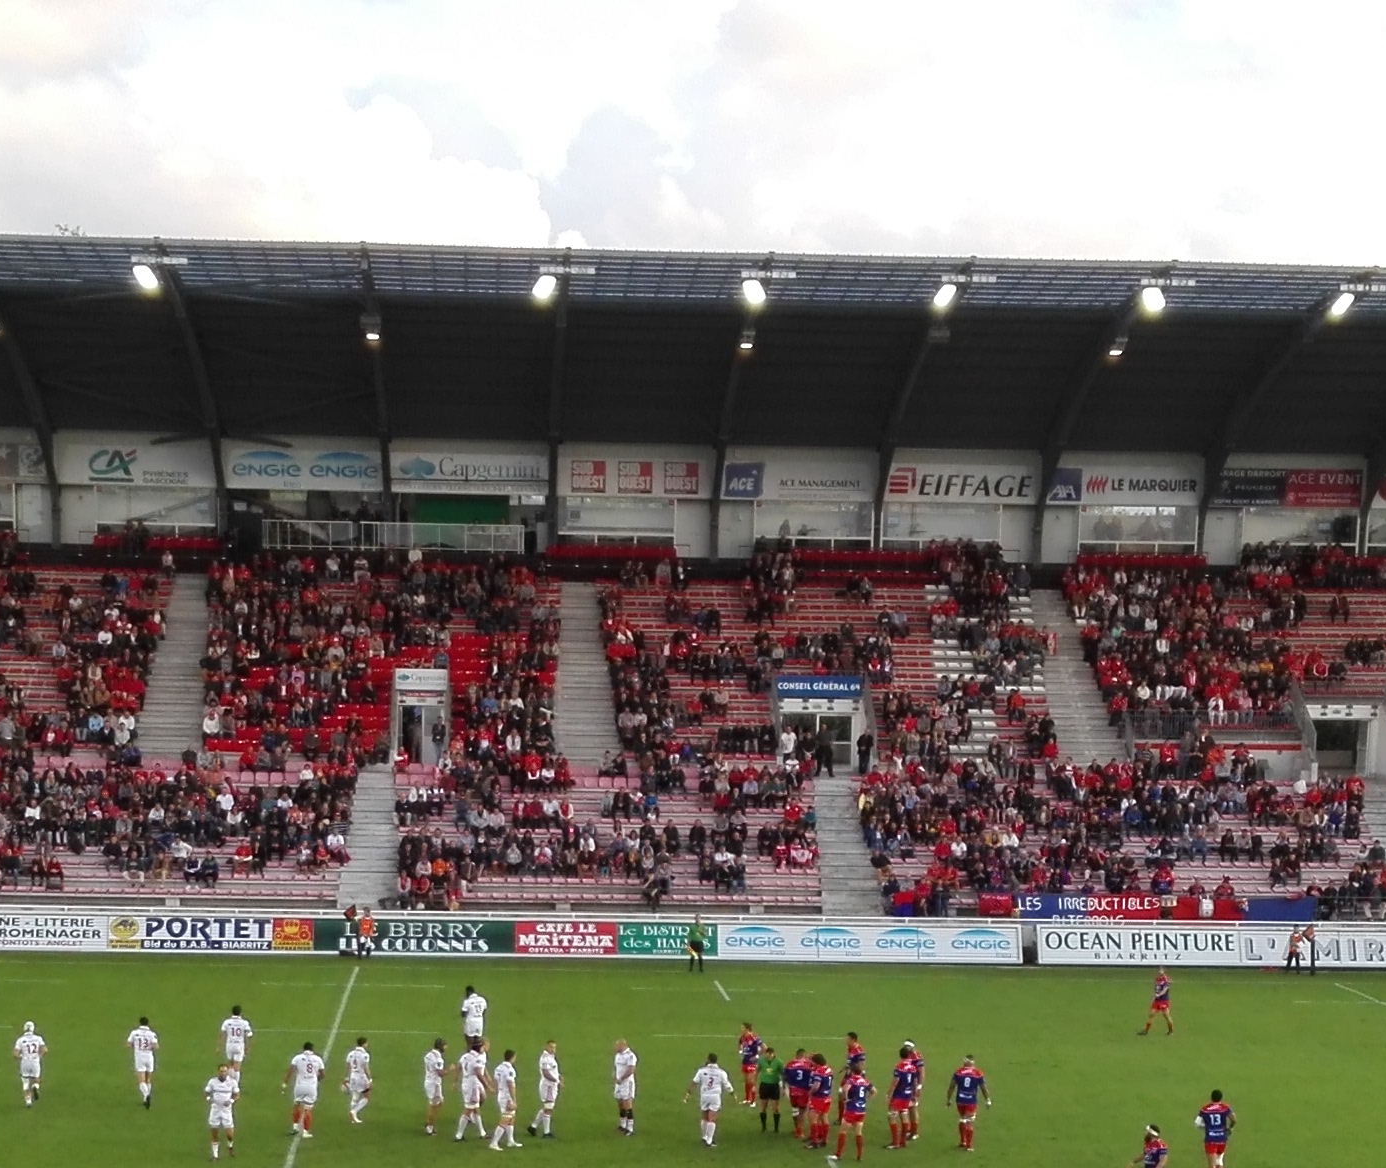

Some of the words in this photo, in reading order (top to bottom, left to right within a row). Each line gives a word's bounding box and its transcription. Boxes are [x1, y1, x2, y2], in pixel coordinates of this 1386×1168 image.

[439, 457, 540, 481] Capgemini
[572, 462, 594, 475] SUD
[618, 462, 640, 475] SUD
[665, 463, 687, 476] SUD
[572, 475, 605, 489] OUEST
[618, 475, 651, 489] OUEST
[665, 476, 698, 490] OUEST
[778, 479, 795, 487] ACE
[798, 479, 860, 488] MANAGEMENT
[918, 474, 1033, 497] EIFFAGE
[1111, 479, 1124, 491] LE
[1128, 479, 1197, 492] MARQUIER
[1289, 474, 1314, 484] ACE
[1319, 474, 1361, 485] EVENT
[1047, 484, 1076, 499] AXA
[778, 682, 811, 690] CONSEIL
[1018, 897, 1042, 911] LES
[1058, 897, 1161, 911] IRREDUCTIBLES
[34, 918, 95, 928] LITERIE
[145, 917, 272, 939] PORTET
[389, 922, 484, 937] BERRY
[577, 923, 597, 933] LE
[619, 924, 637, 936] Le
[643, 924, 715, 937] BISTRT
[143, 940, 160, 949] Bld
[164, 940, 177, 949] du
[222, 941, 269, 950] BIARRITZ
[382, 938, 489, 952] COLONNES
[623, 937, 651, 948] des
[1045, 931, 1122, 950] OCEAN
[1131, 933, 1235, 952] PEINTURE
[1094, 952, 1182, 961] BIARRITZ
[231, 1028, 242, 1037] 10
[26, 1043, 37, 1054] 12
[306, 1063, 313, 1073] 8
[1210, 1114, 1221, 1125] 13
